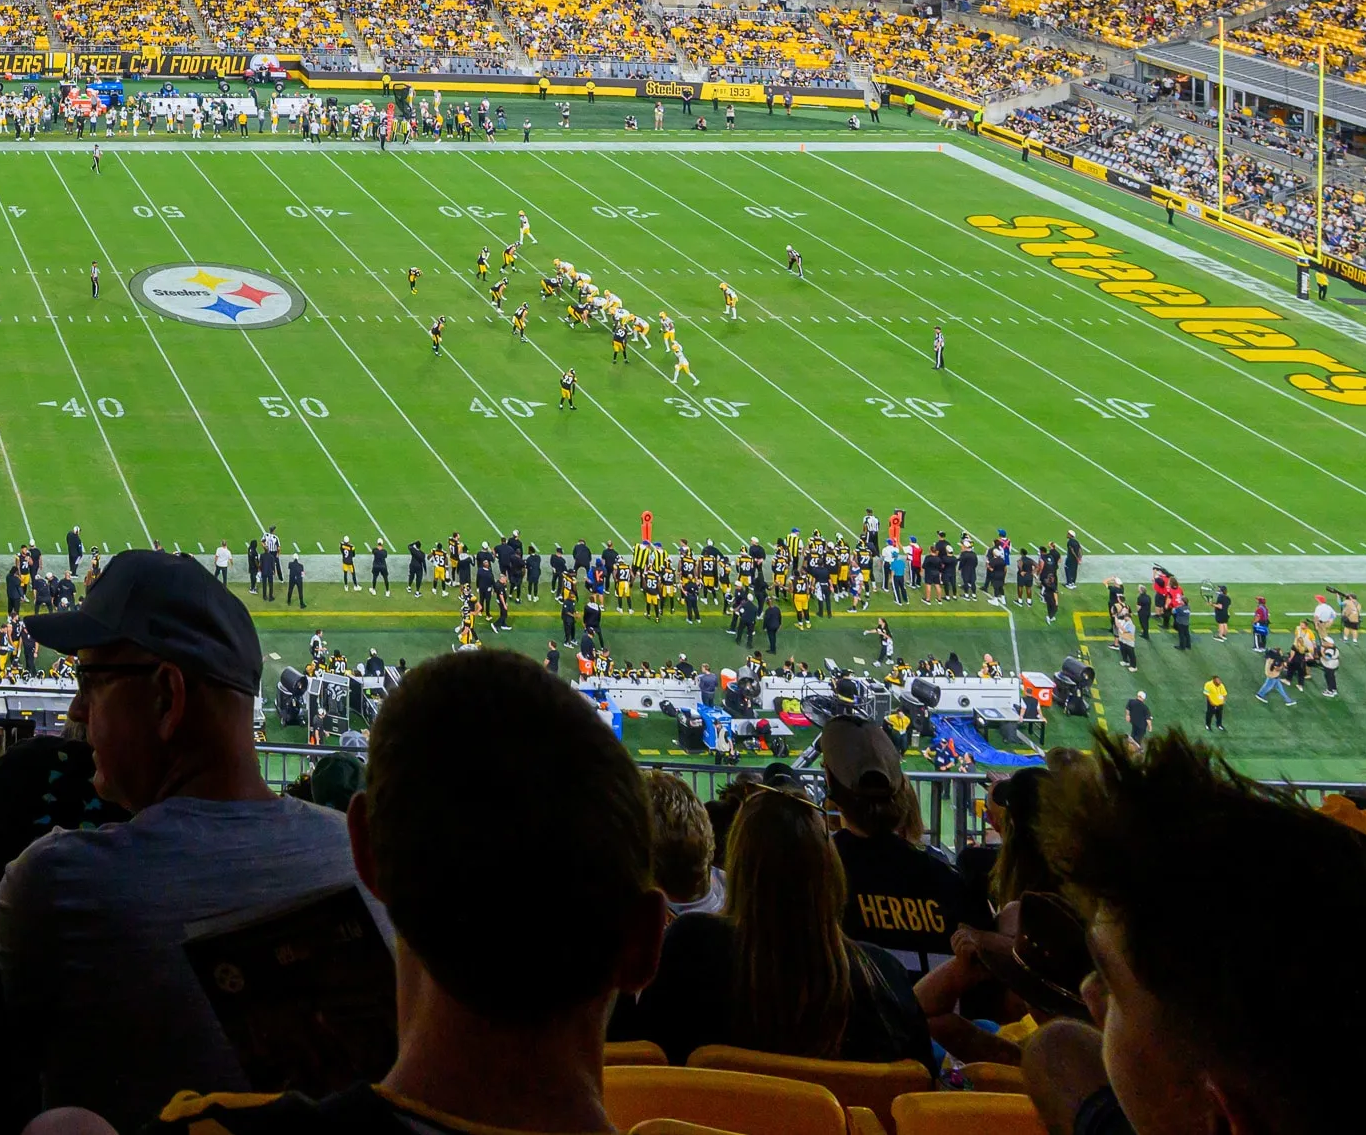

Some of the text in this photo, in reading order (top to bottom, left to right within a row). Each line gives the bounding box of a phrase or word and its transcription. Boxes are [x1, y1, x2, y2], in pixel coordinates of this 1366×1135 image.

[78, 54, 124, 74] STEEL
[170, 54, 247, 74] FOOTBALL
[730, 88, 751, 97] 1933
[151, 268, 191, 298] Steelers
[562, 374, 573, 385] 23
[60, 397, 126, 418] 40
[257, 397, 331, 418] 50
[468, 397, 536, 418] 40
[662, 397, 739, 418] 30
[864, 397, 941, 418] 20
[1073, 397, 1147, 419] 10
[343, 550, 350, 559] 9
[434, 554, 445, 566] 35
[839, 553, 850, 564] 92
[683, 562, 694, 572] 39
[703, 560, 714, 571] 53
[741, 561, 751, 571] 48
[776, 561, 786, 572] 27
[825, 557, 836, 567] 95
[619, 569, 630, 579] 27
[646, 579, 658, 589] 85
[795, 583, 807, 594] 94
[335, 661, 346, 674] 20
[596, 661, 608, 670] 83
[1038, 690, 1050, 703] G
[858, 894, 945, 933] HERBIG
